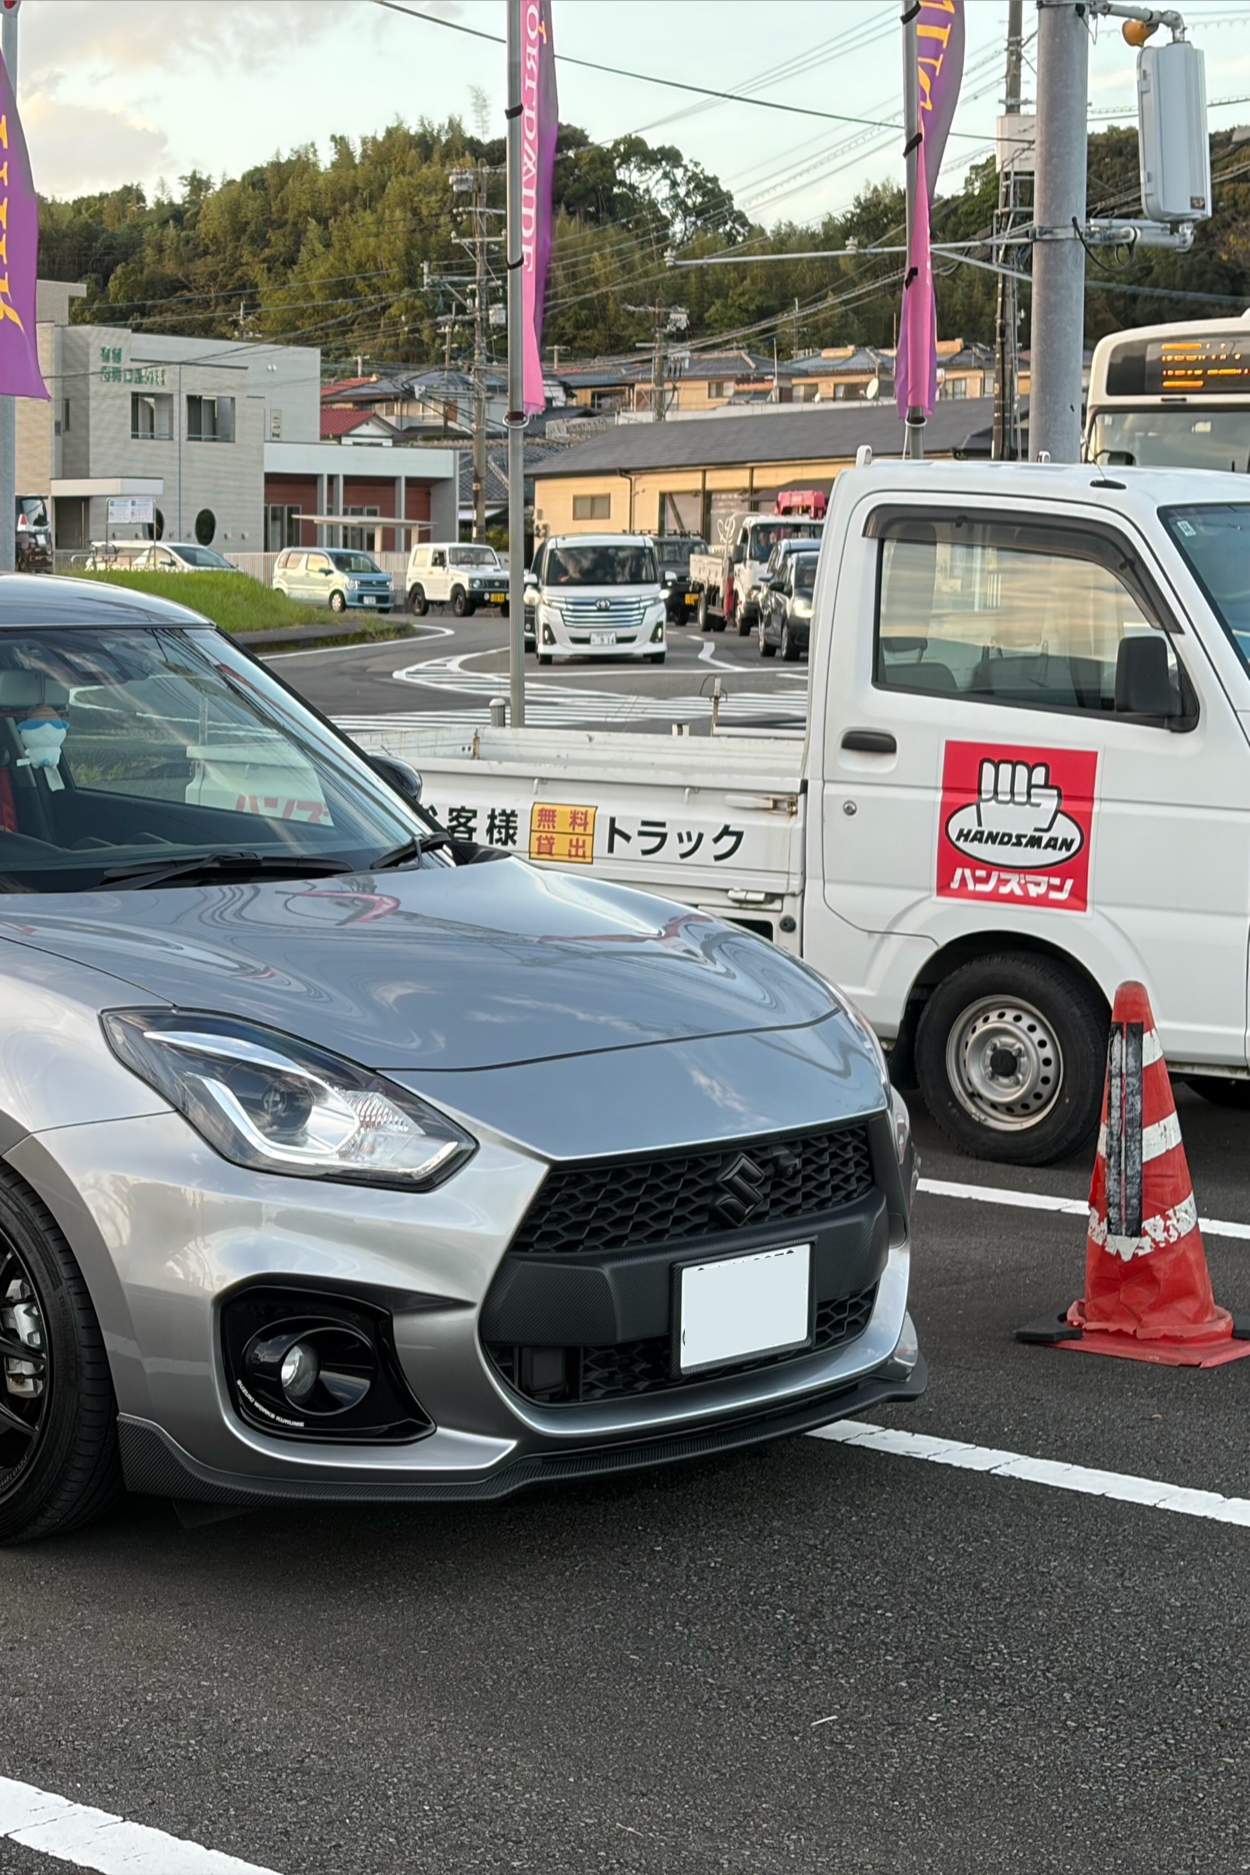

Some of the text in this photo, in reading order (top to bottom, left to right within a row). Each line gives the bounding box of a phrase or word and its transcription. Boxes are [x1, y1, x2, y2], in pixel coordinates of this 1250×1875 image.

[537, 807, 589, 832] 無料
[535, 835, 587, 859] 貸出
[607, 816, 745, 862] トラック
[955, 828, 1075, 852] HANDSMAN
[950, 867, 1074, 901] ハンズマン
